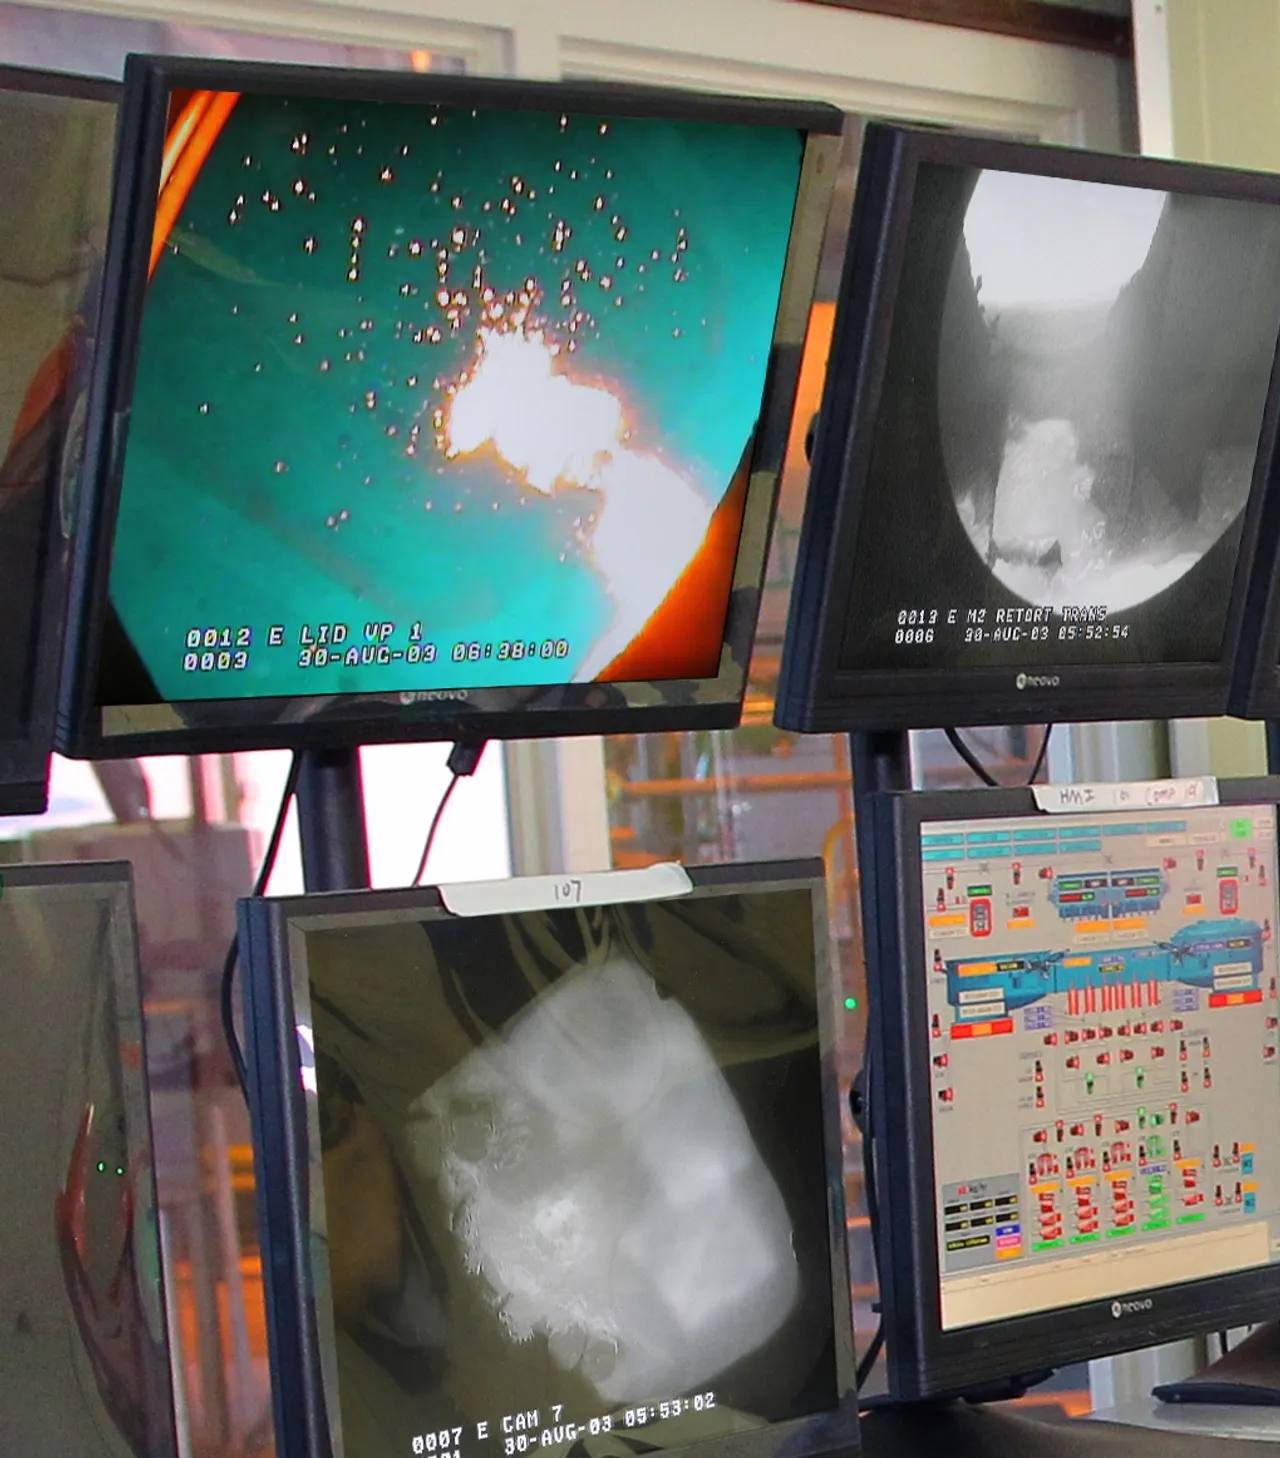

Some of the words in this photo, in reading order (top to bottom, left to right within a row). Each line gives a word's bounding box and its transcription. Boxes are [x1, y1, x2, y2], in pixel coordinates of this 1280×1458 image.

[947, 609, 957, 624] E
[996, 607, 1054, 624] RETORT
[186, 628, 251, 648] 0012
[268, 626, 285, 646] E
[300, 624, 348, 645] LID
[409, 622, 423, 641] 1
[183, 651, 249, 672] 0003
[298, 643, 437, 668] 30-AUG-03
[451, 639, 571, 662] 06:38:00
[553, 879, 583, 902] 107
[412, 1427, 464, 1455] 0007
[476, 1421, 489, 1440] E
[502, 1409, 540, 1434] CAM
[551, 1404, 563, 1422] 7
[504, 1415, 613, 1456] 30-AUG-03
[625, 1391, 716, 1427] 05:53:02
